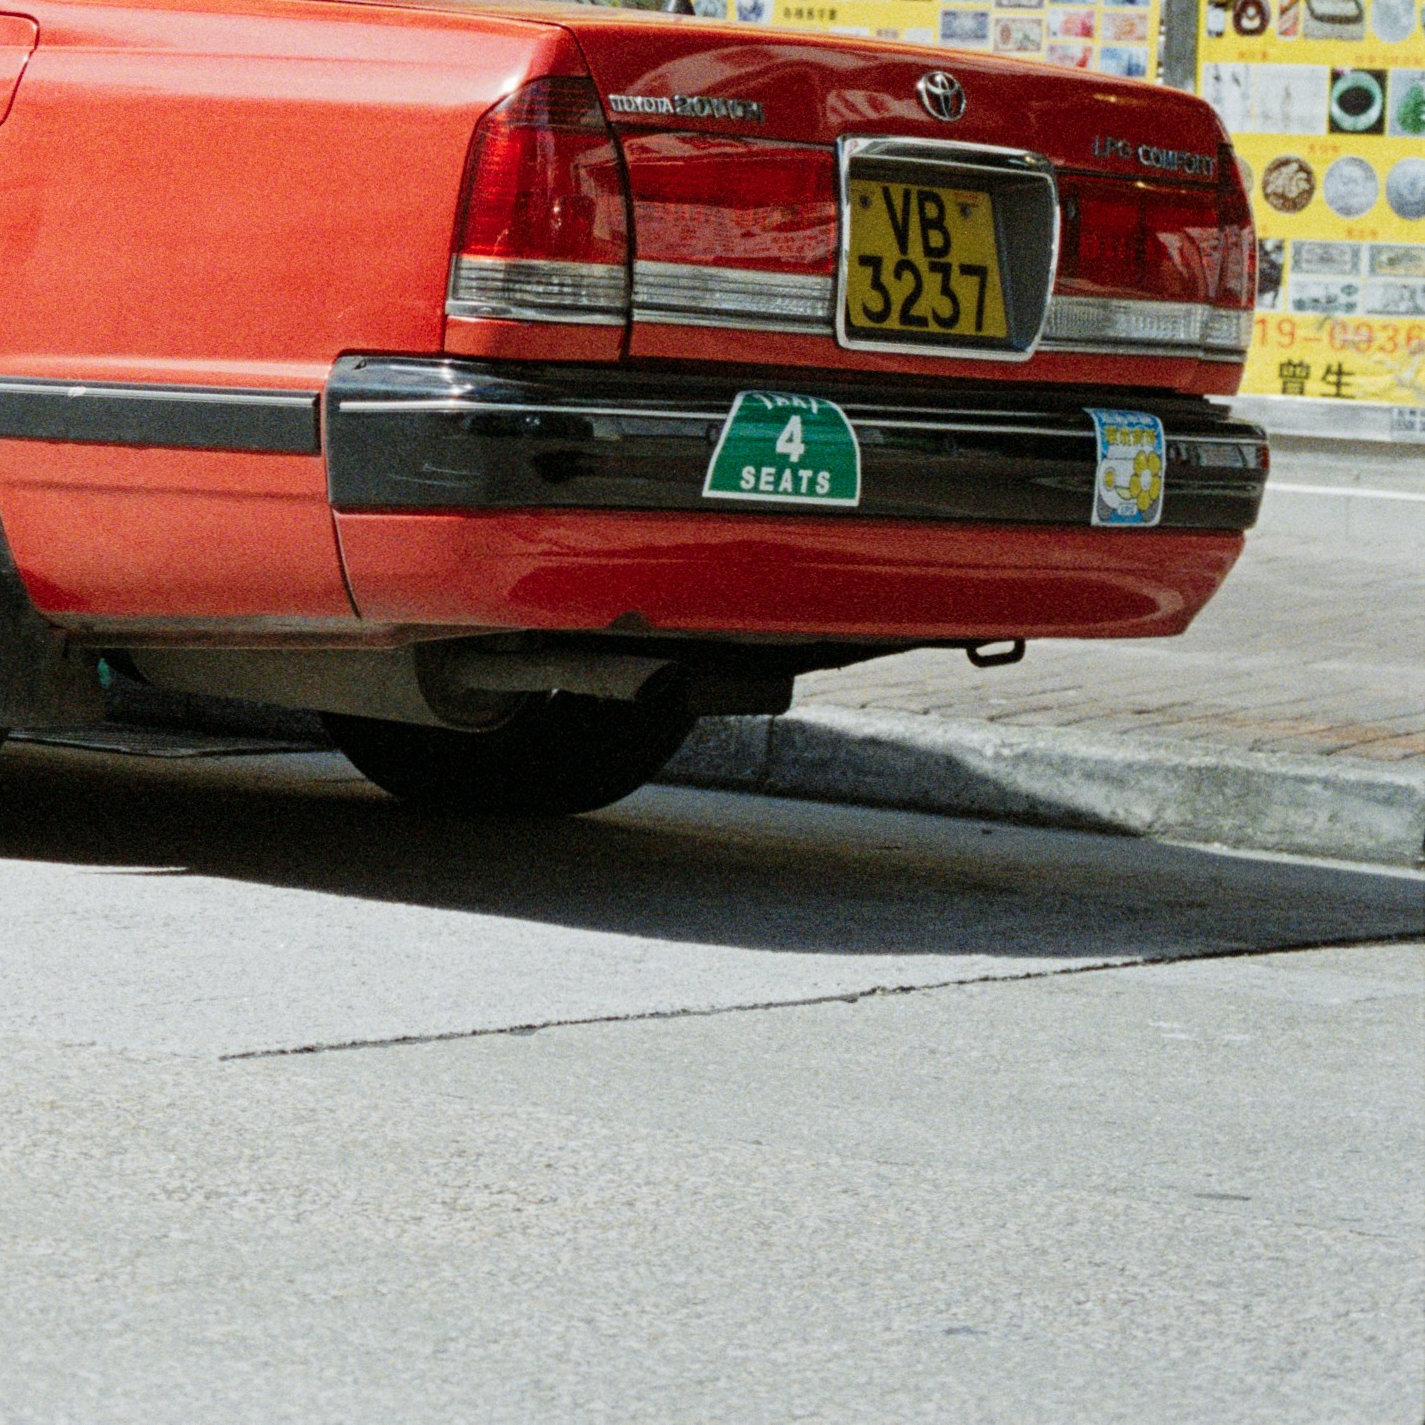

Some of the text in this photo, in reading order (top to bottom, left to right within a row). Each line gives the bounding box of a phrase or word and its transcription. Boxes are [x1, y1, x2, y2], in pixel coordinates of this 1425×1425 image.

[609, 93, 674, 113] TOYOTA
[882, 185, 952, 259] VB
[858, 254, 989, 333] 3237
[1279, 360, 1356, 398] 曾生
[776, 415, 805, 463] 4
[740, 465, 830, 495] SEATS
